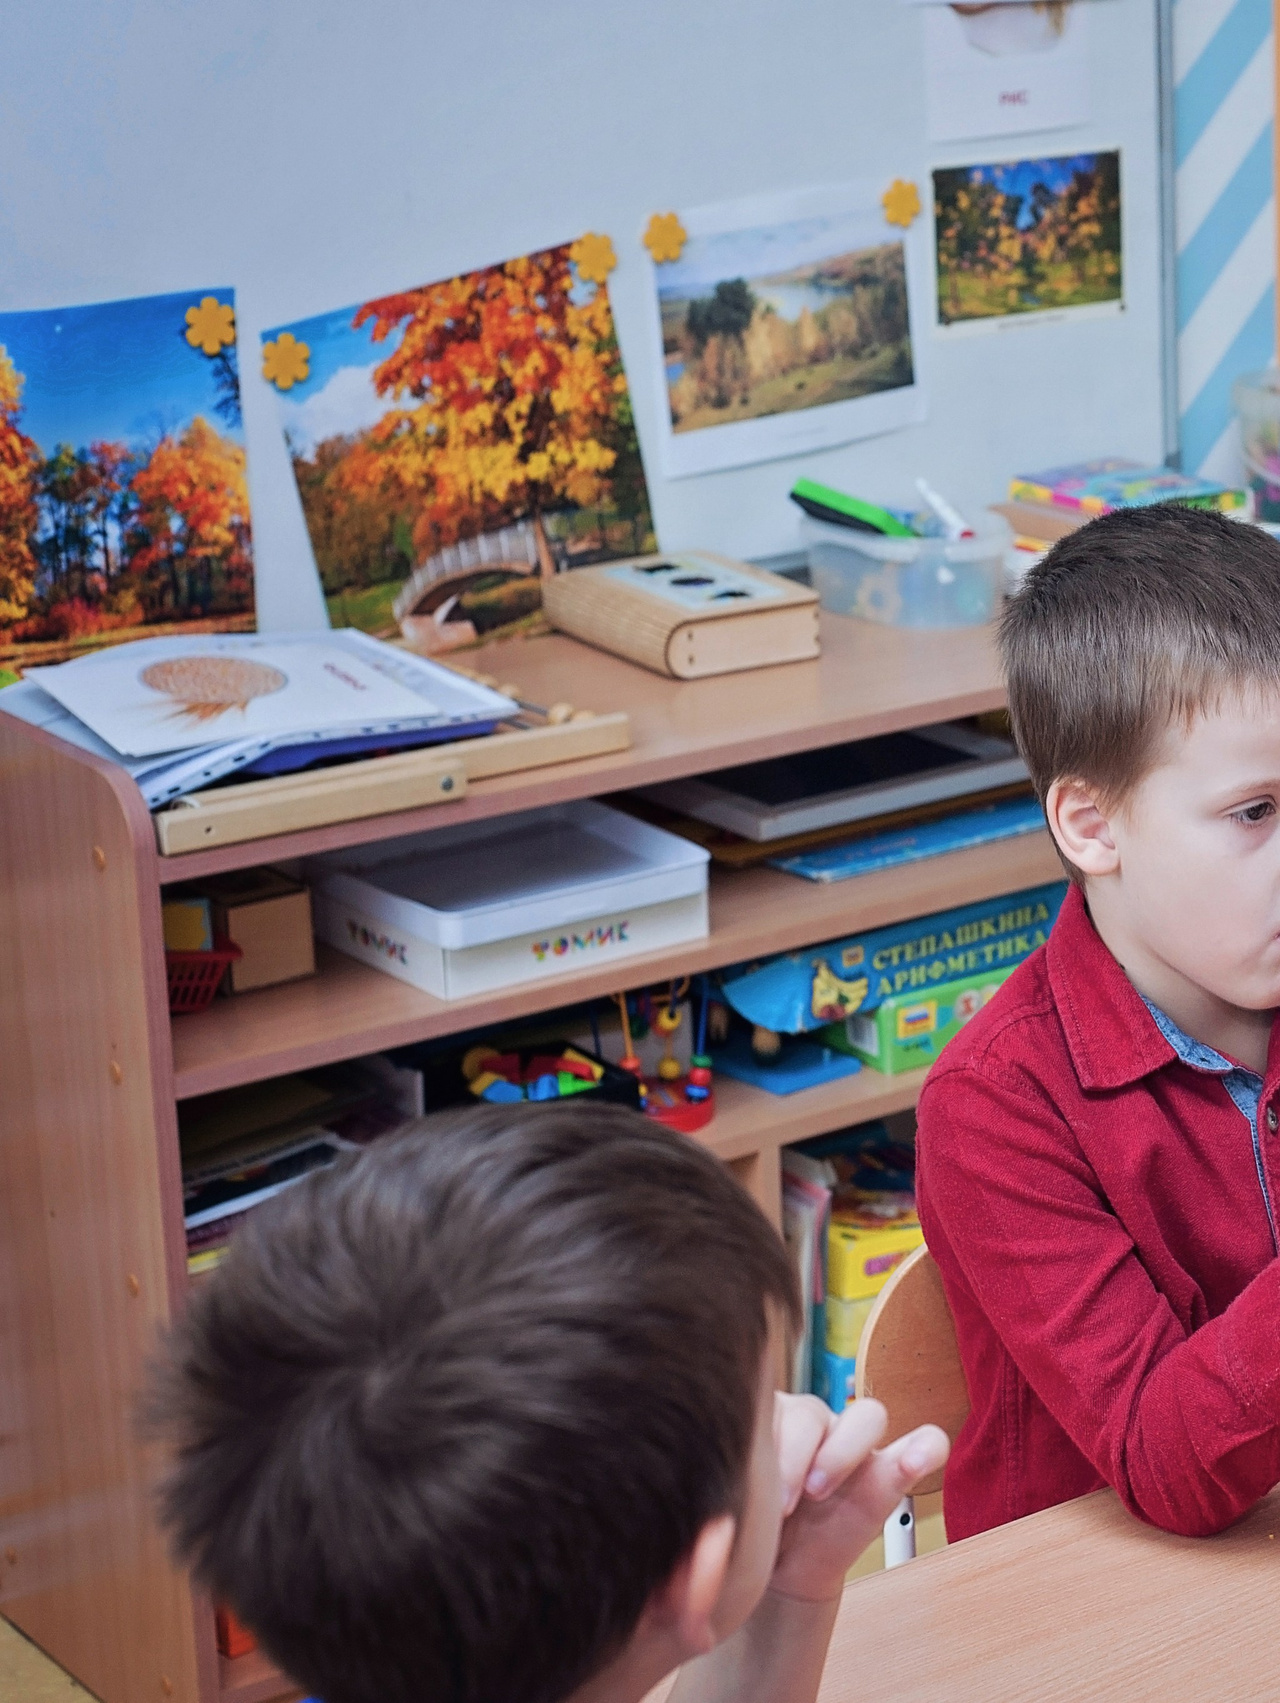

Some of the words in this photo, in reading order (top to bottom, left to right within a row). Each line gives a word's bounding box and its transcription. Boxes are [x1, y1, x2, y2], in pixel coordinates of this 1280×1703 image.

[532, 920, 629, 962] ТОМИК
[872, 903, 1049, 970] СТЕПАШКИНА
[877, 929, 1048, 997] АРИФМЕТИКА
